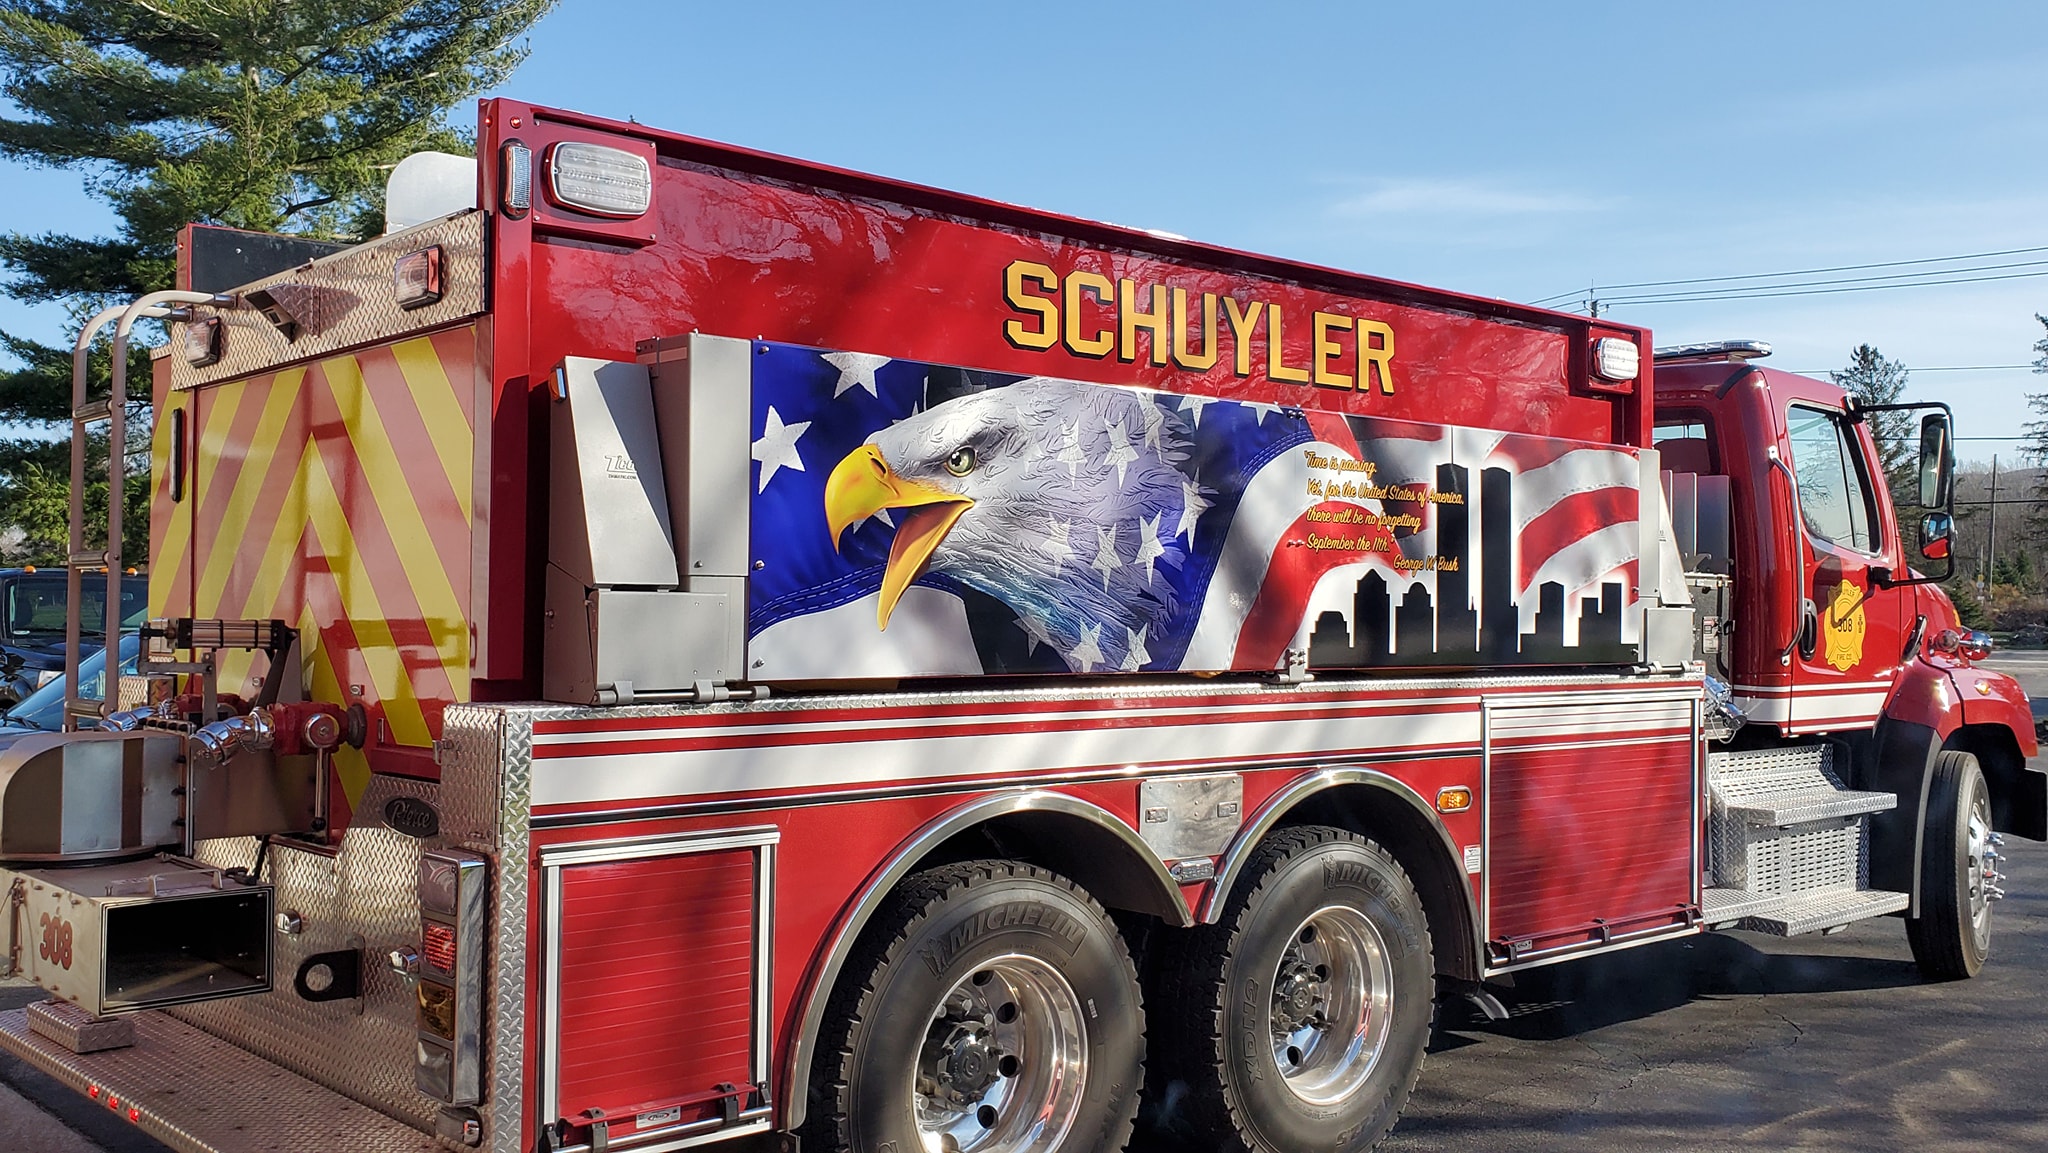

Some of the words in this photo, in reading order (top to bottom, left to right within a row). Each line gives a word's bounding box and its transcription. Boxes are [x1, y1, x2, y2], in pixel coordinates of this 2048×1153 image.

[1003, 260, 1396, 397] SCHUYLER
[1329, 456, 1338, 470] is
[1324, 480, 1341, 502] for
[1342, 480, 1357, 497] the
[1358, 482, 1388, 500] United
[1388, 485, 1416, 501] States
[1416, 488, 1427, 508] of
[1307, 506, 1331, 522] there
[1333, 508, 1352, 524] will
[1353, 509, 1364, 524] be
[1365, 514, 1376, 525] no
[1376, 511, 1421, 534] forgetting
[1306, 533, 1355, 554] September
[1356, 535, 1371, 551] the
[1393, 554, 1424, 577] George
[1437, 555, 1459, 572] Bush
[1837, 618, 1853, 633] 308
[391, 800, 431, 829] Pierce
[40, 911, 73, 971] 308
[951, 903, 1086, 954] MICHELIN
[1243, 977, 1264, 1086] XDN2
